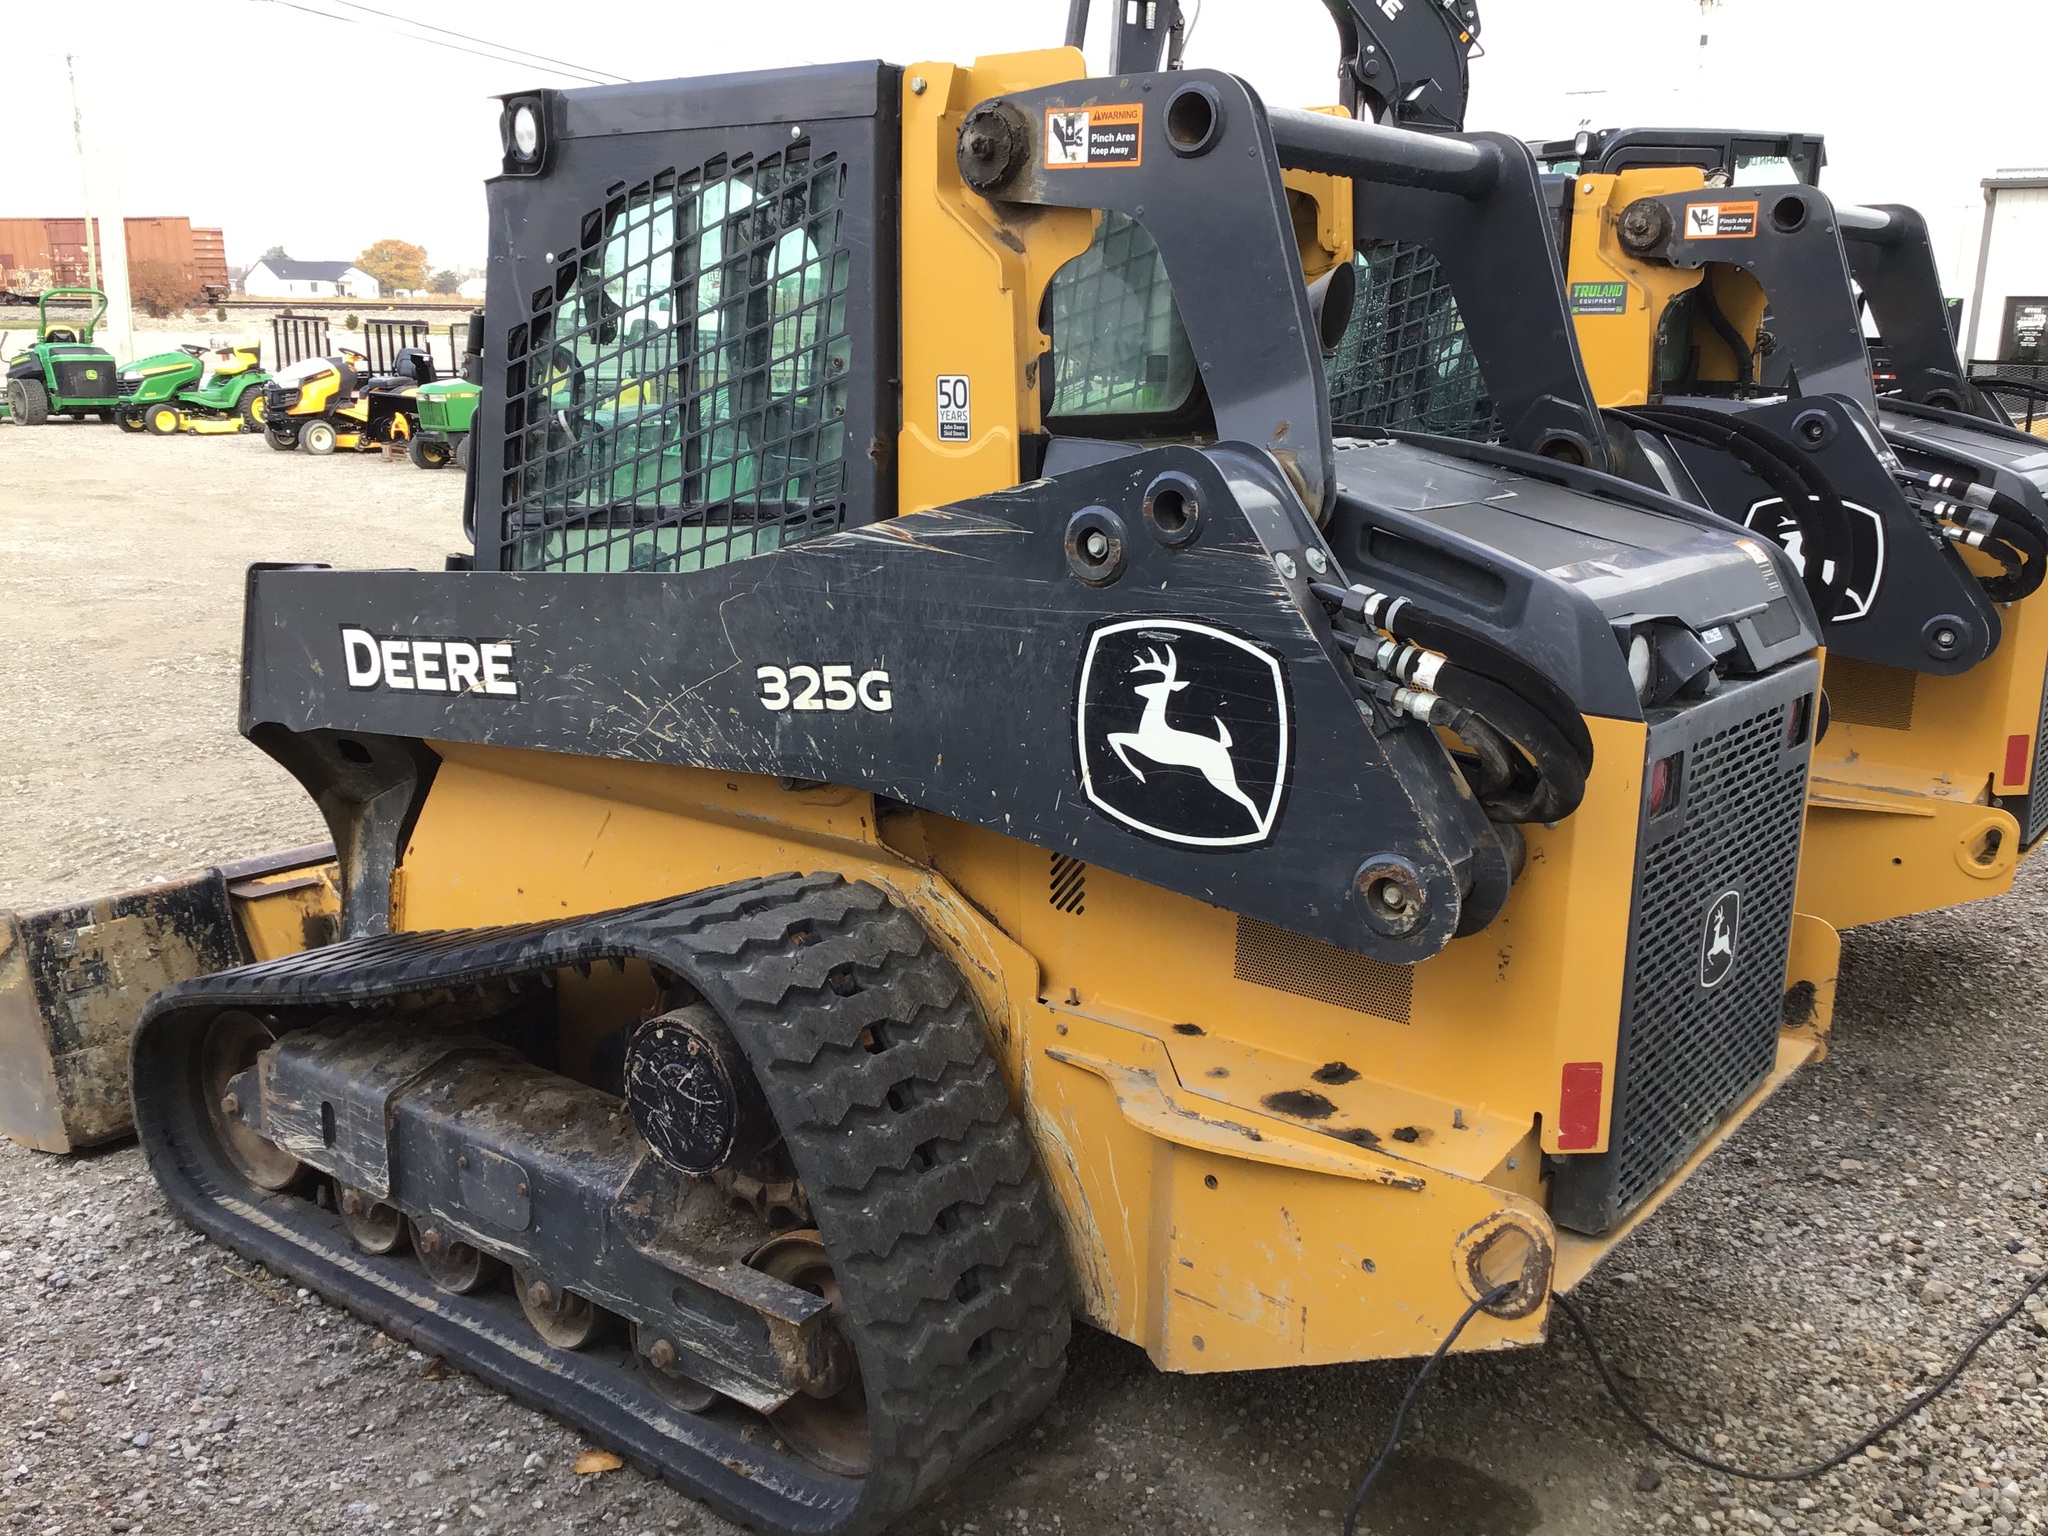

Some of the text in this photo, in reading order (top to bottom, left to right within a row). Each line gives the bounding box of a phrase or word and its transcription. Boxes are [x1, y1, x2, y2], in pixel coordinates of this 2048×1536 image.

[1101, 110, 1138, 120] WARNING
[1091, 132, 1136, 143] Pinch Area
[1090, 146, 1129, 156] Keep Away
[1574, 284, 1624, 298] TRULAND
[939, 378, 968, 409] 50
[940, 410, 968, 421] YEARS
[341, 628, 518, 695] DEERE
[756, 665, 893, 712] 325G
